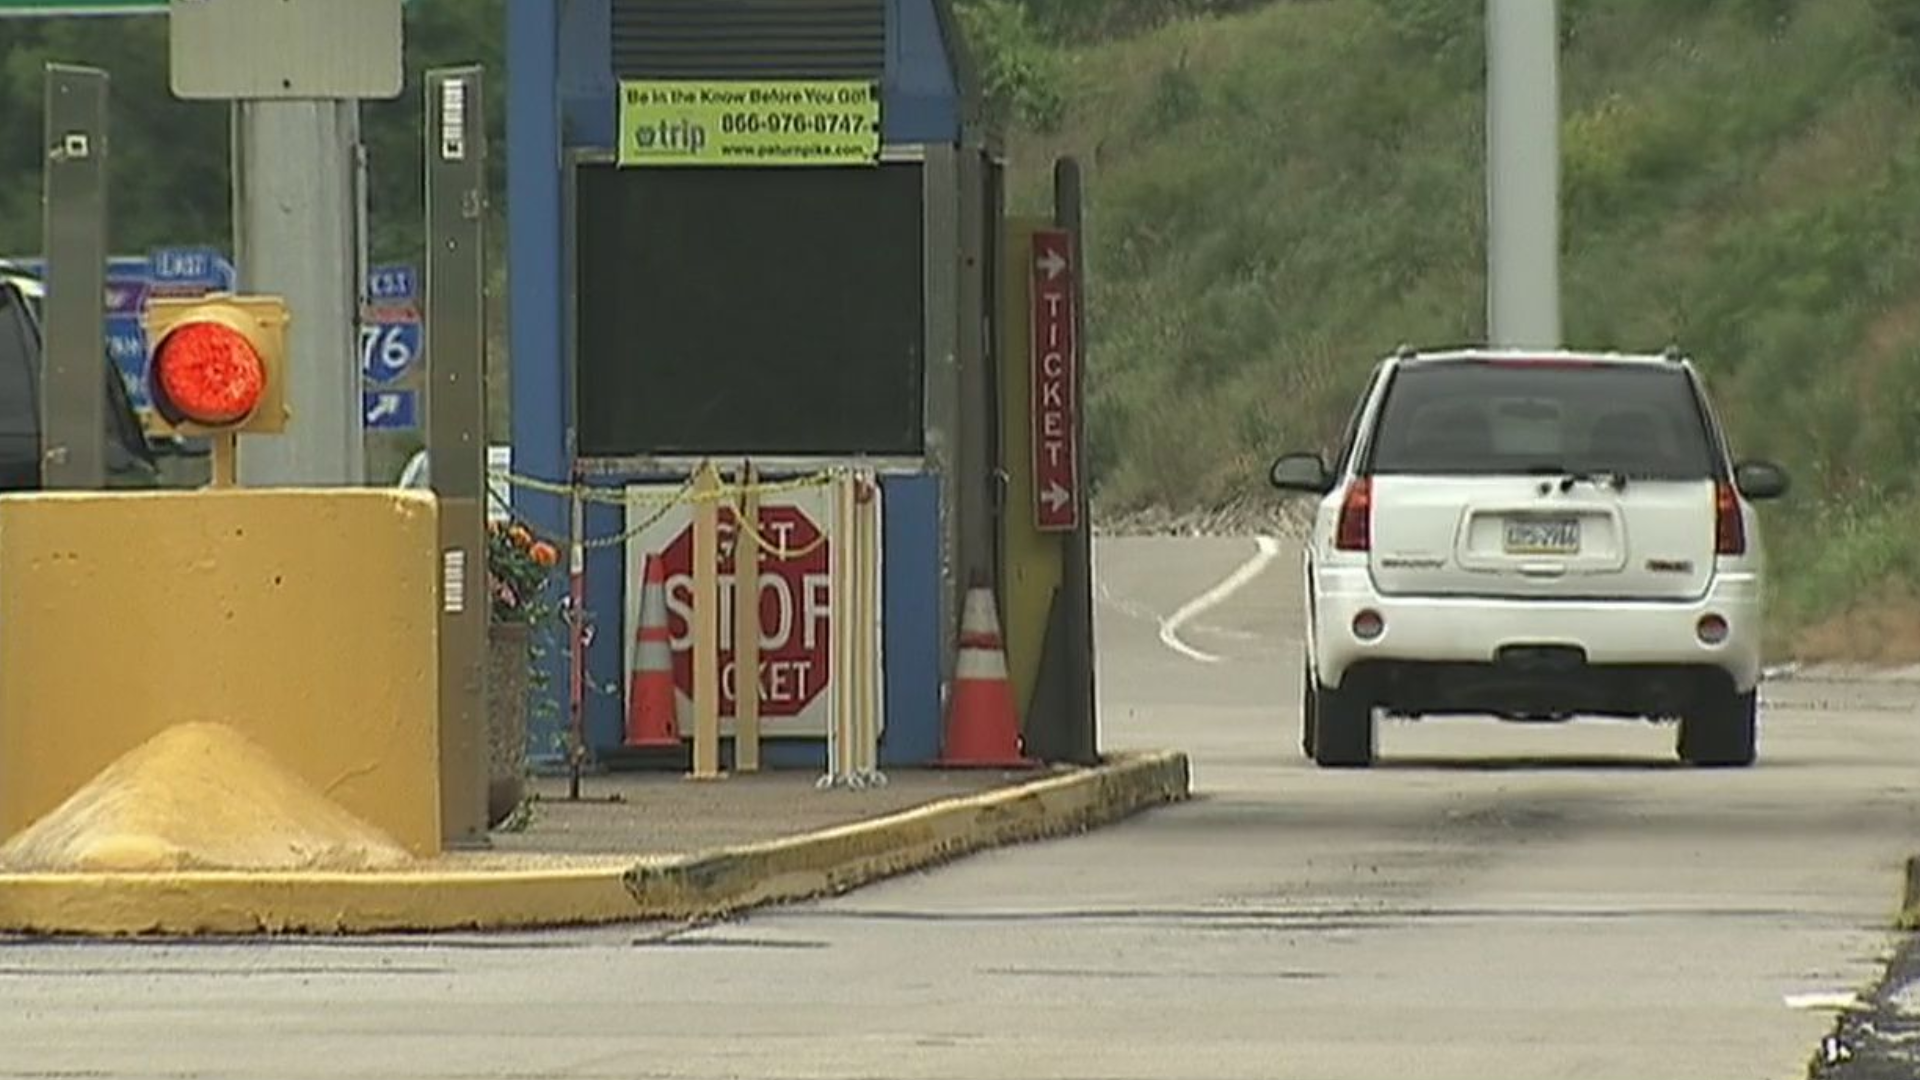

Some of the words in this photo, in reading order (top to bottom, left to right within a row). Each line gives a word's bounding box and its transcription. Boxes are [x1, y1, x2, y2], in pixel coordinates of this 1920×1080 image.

[626, 88, 649, 104] Be
[670, 88, 696, 104] the
[700, 88, 747, 104] Know
[750, 88, 802, 104] Before
[804, 87, 834, 104] You
[838, 87, 866, 104] Go!
[660, 118, 705, 155] trip
[362, 326, 410, 369] 76
[1043, 292, 1062, 467] TICKET
